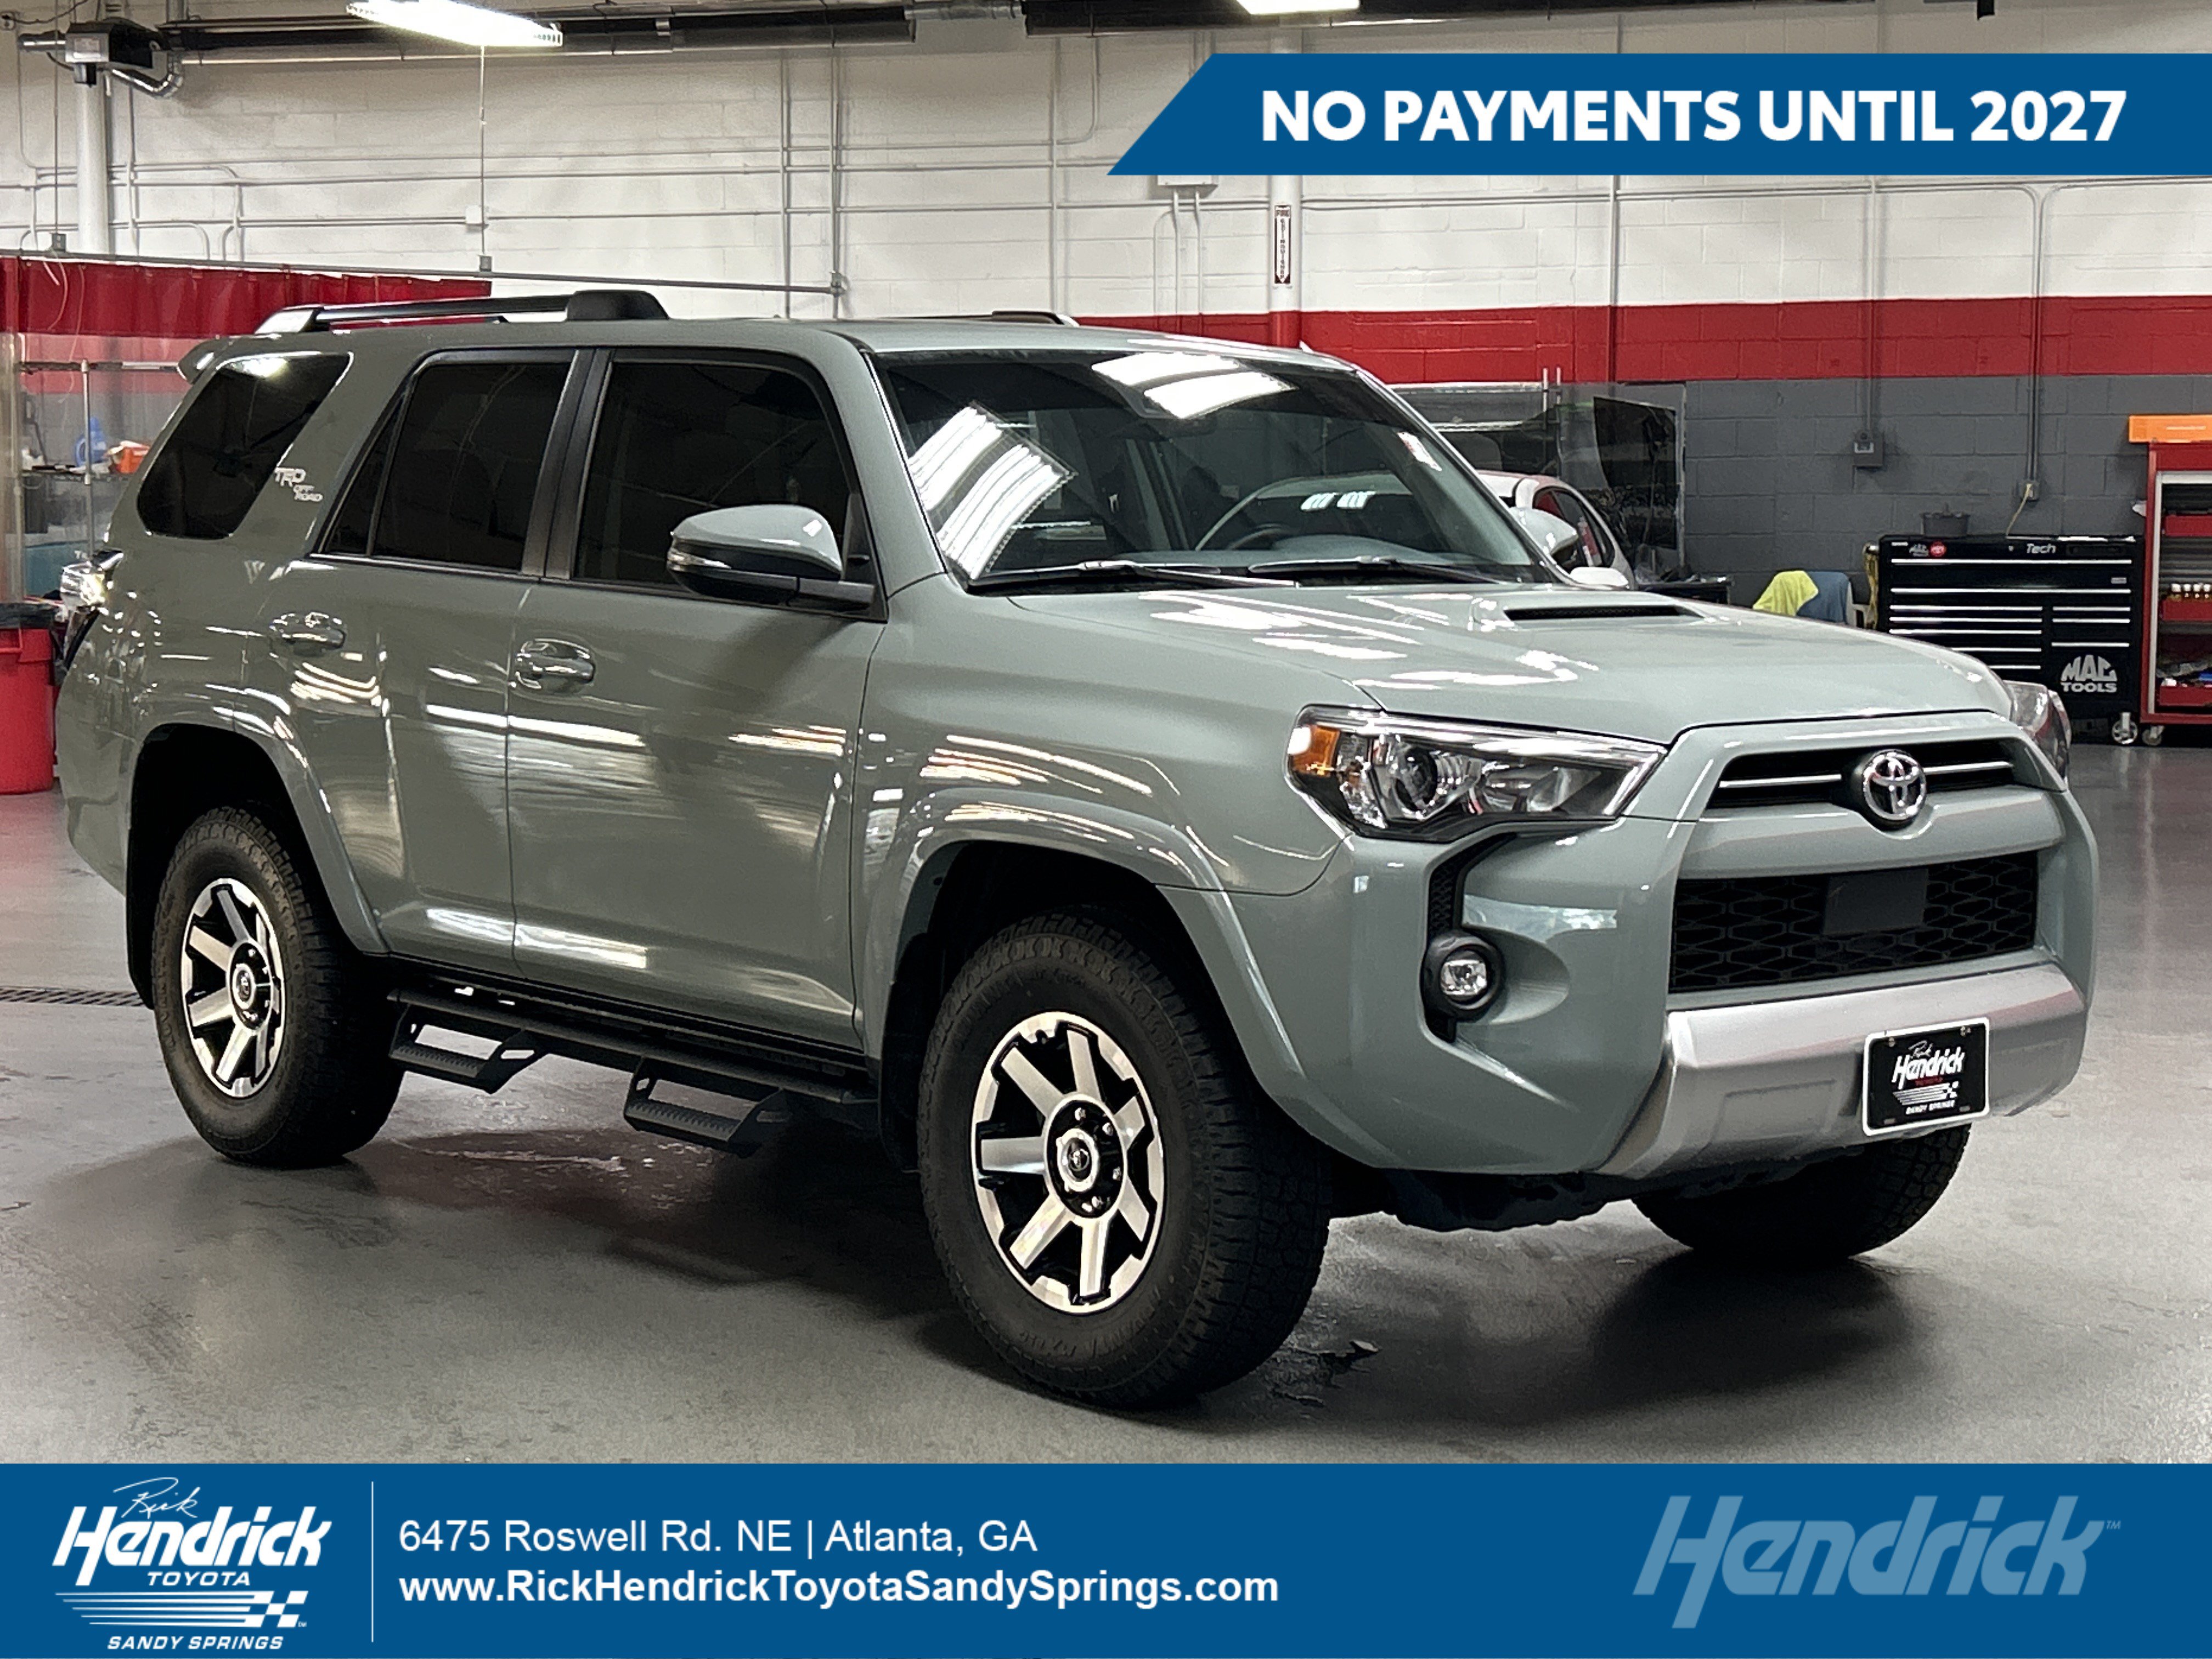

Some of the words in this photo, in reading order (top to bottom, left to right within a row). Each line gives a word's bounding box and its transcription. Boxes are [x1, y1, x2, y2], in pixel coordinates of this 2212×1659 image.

[275, 467, 306, 487] TRD
[2027, 543, 2056, 554] Tech
[2061, 654, 2118, 681] MAC
[2060, 682, 2118, 692] TOOLS
[1892, 1046, 1966, 1090] Hendrick
